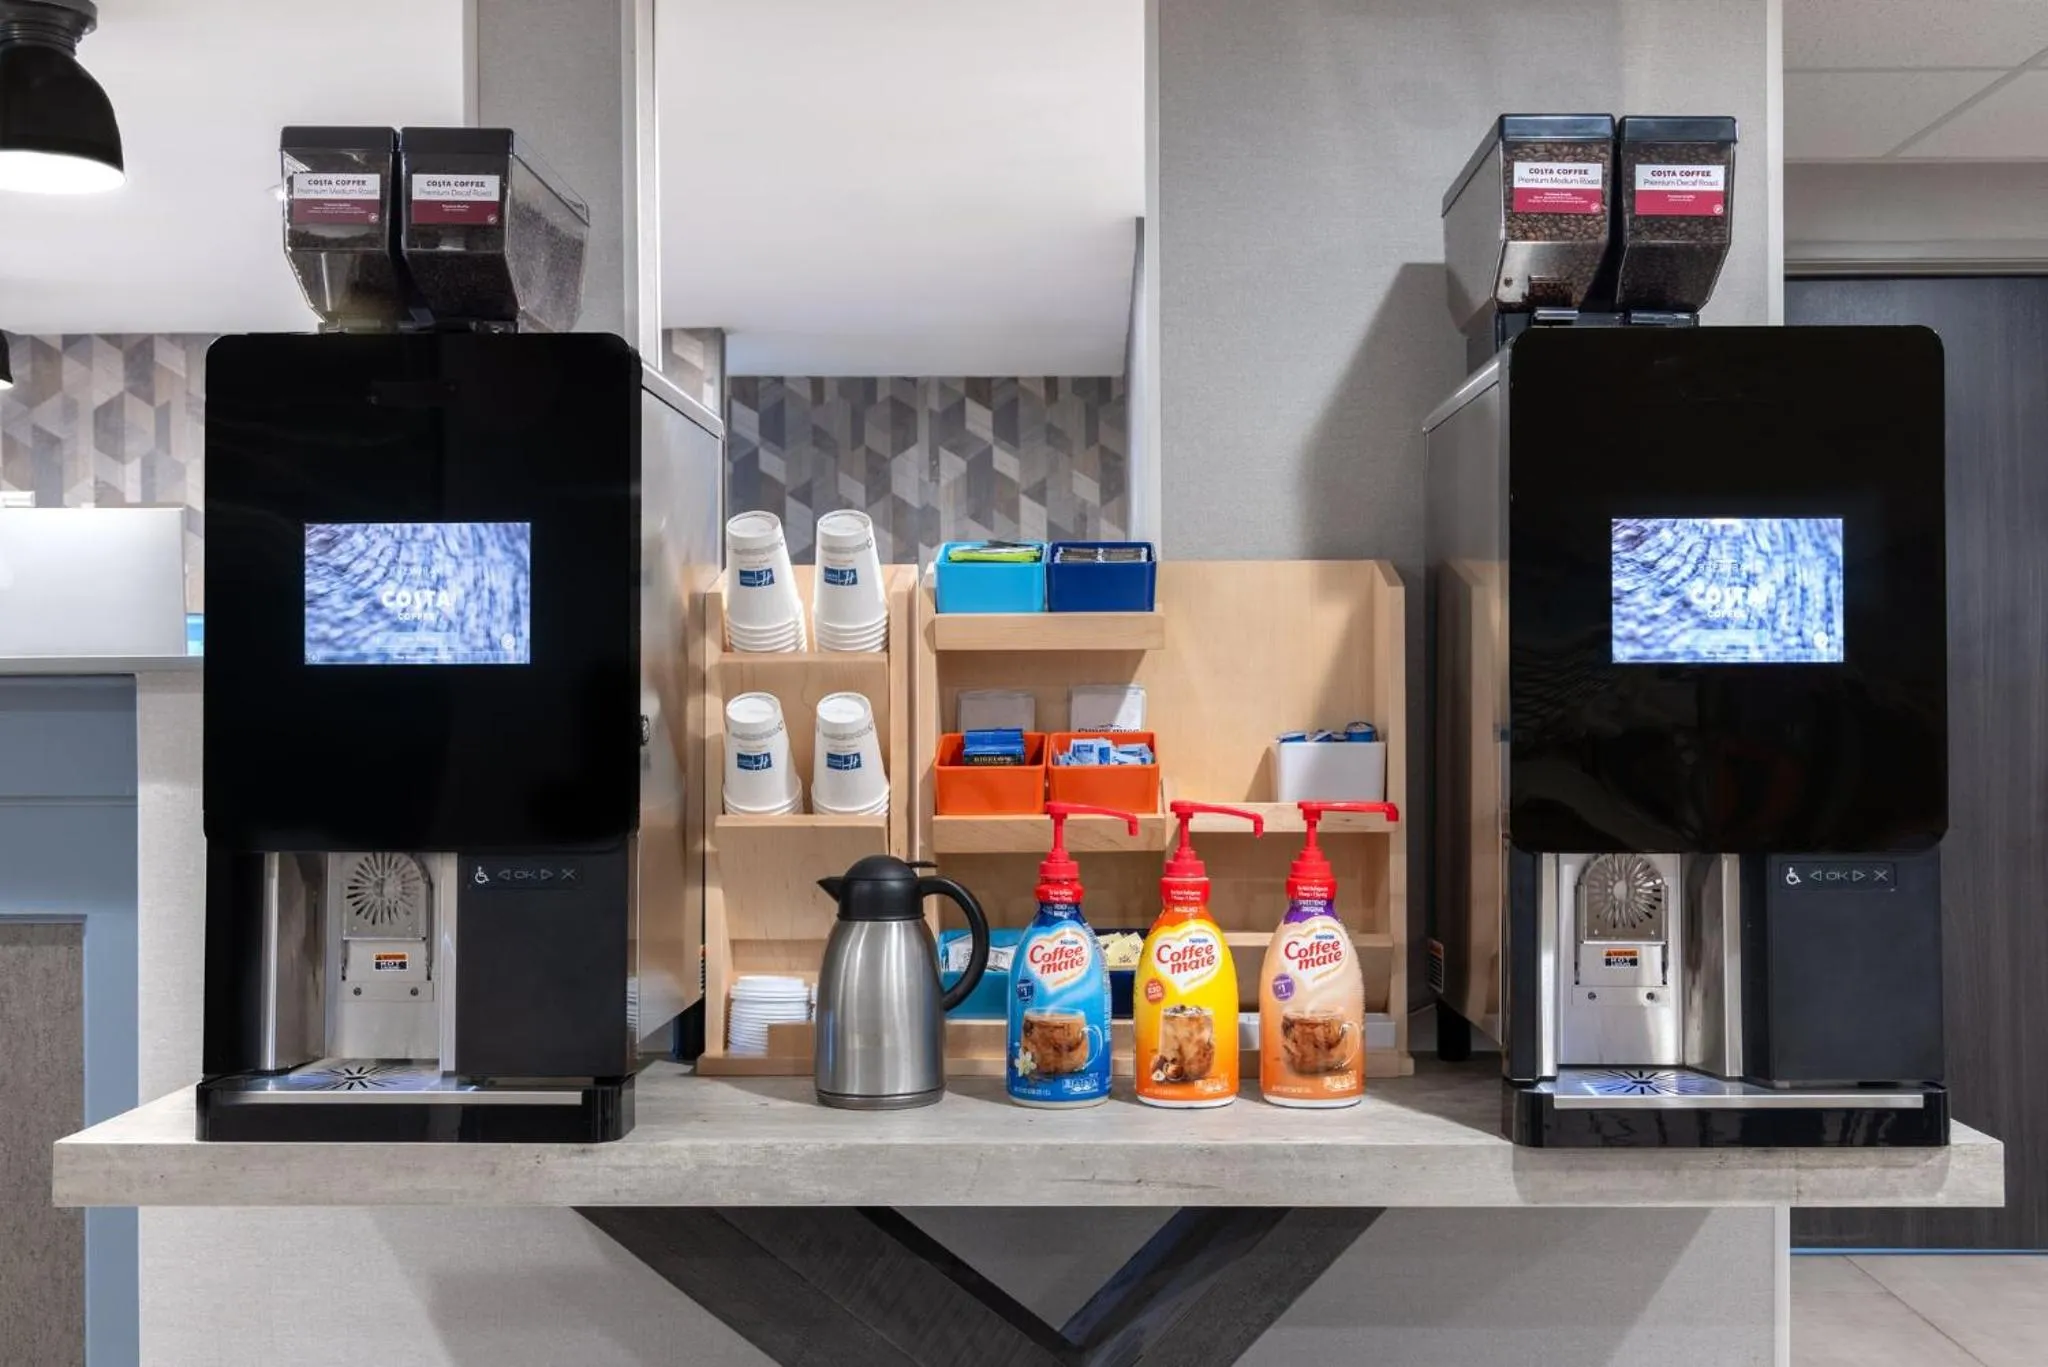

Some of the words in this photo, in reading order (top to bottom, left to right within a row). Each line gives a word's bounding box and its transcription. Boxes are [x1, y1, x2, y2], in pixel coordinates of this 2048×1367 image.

[381, 588, 450, 610] COSTA
[514, 870, 537, 880] OK
[1826, 871, 1848, 880] OK
[1029, 944, 1084, 964] Coffee
[1156, 944, 1214, 964] Coffee
[1284, 940, 1341, 960] Coffee
[1040, 956, 1085, 975] mate
[1171, 955, 1215, 975] mate
[1298, 951, 1342, 971] mate
